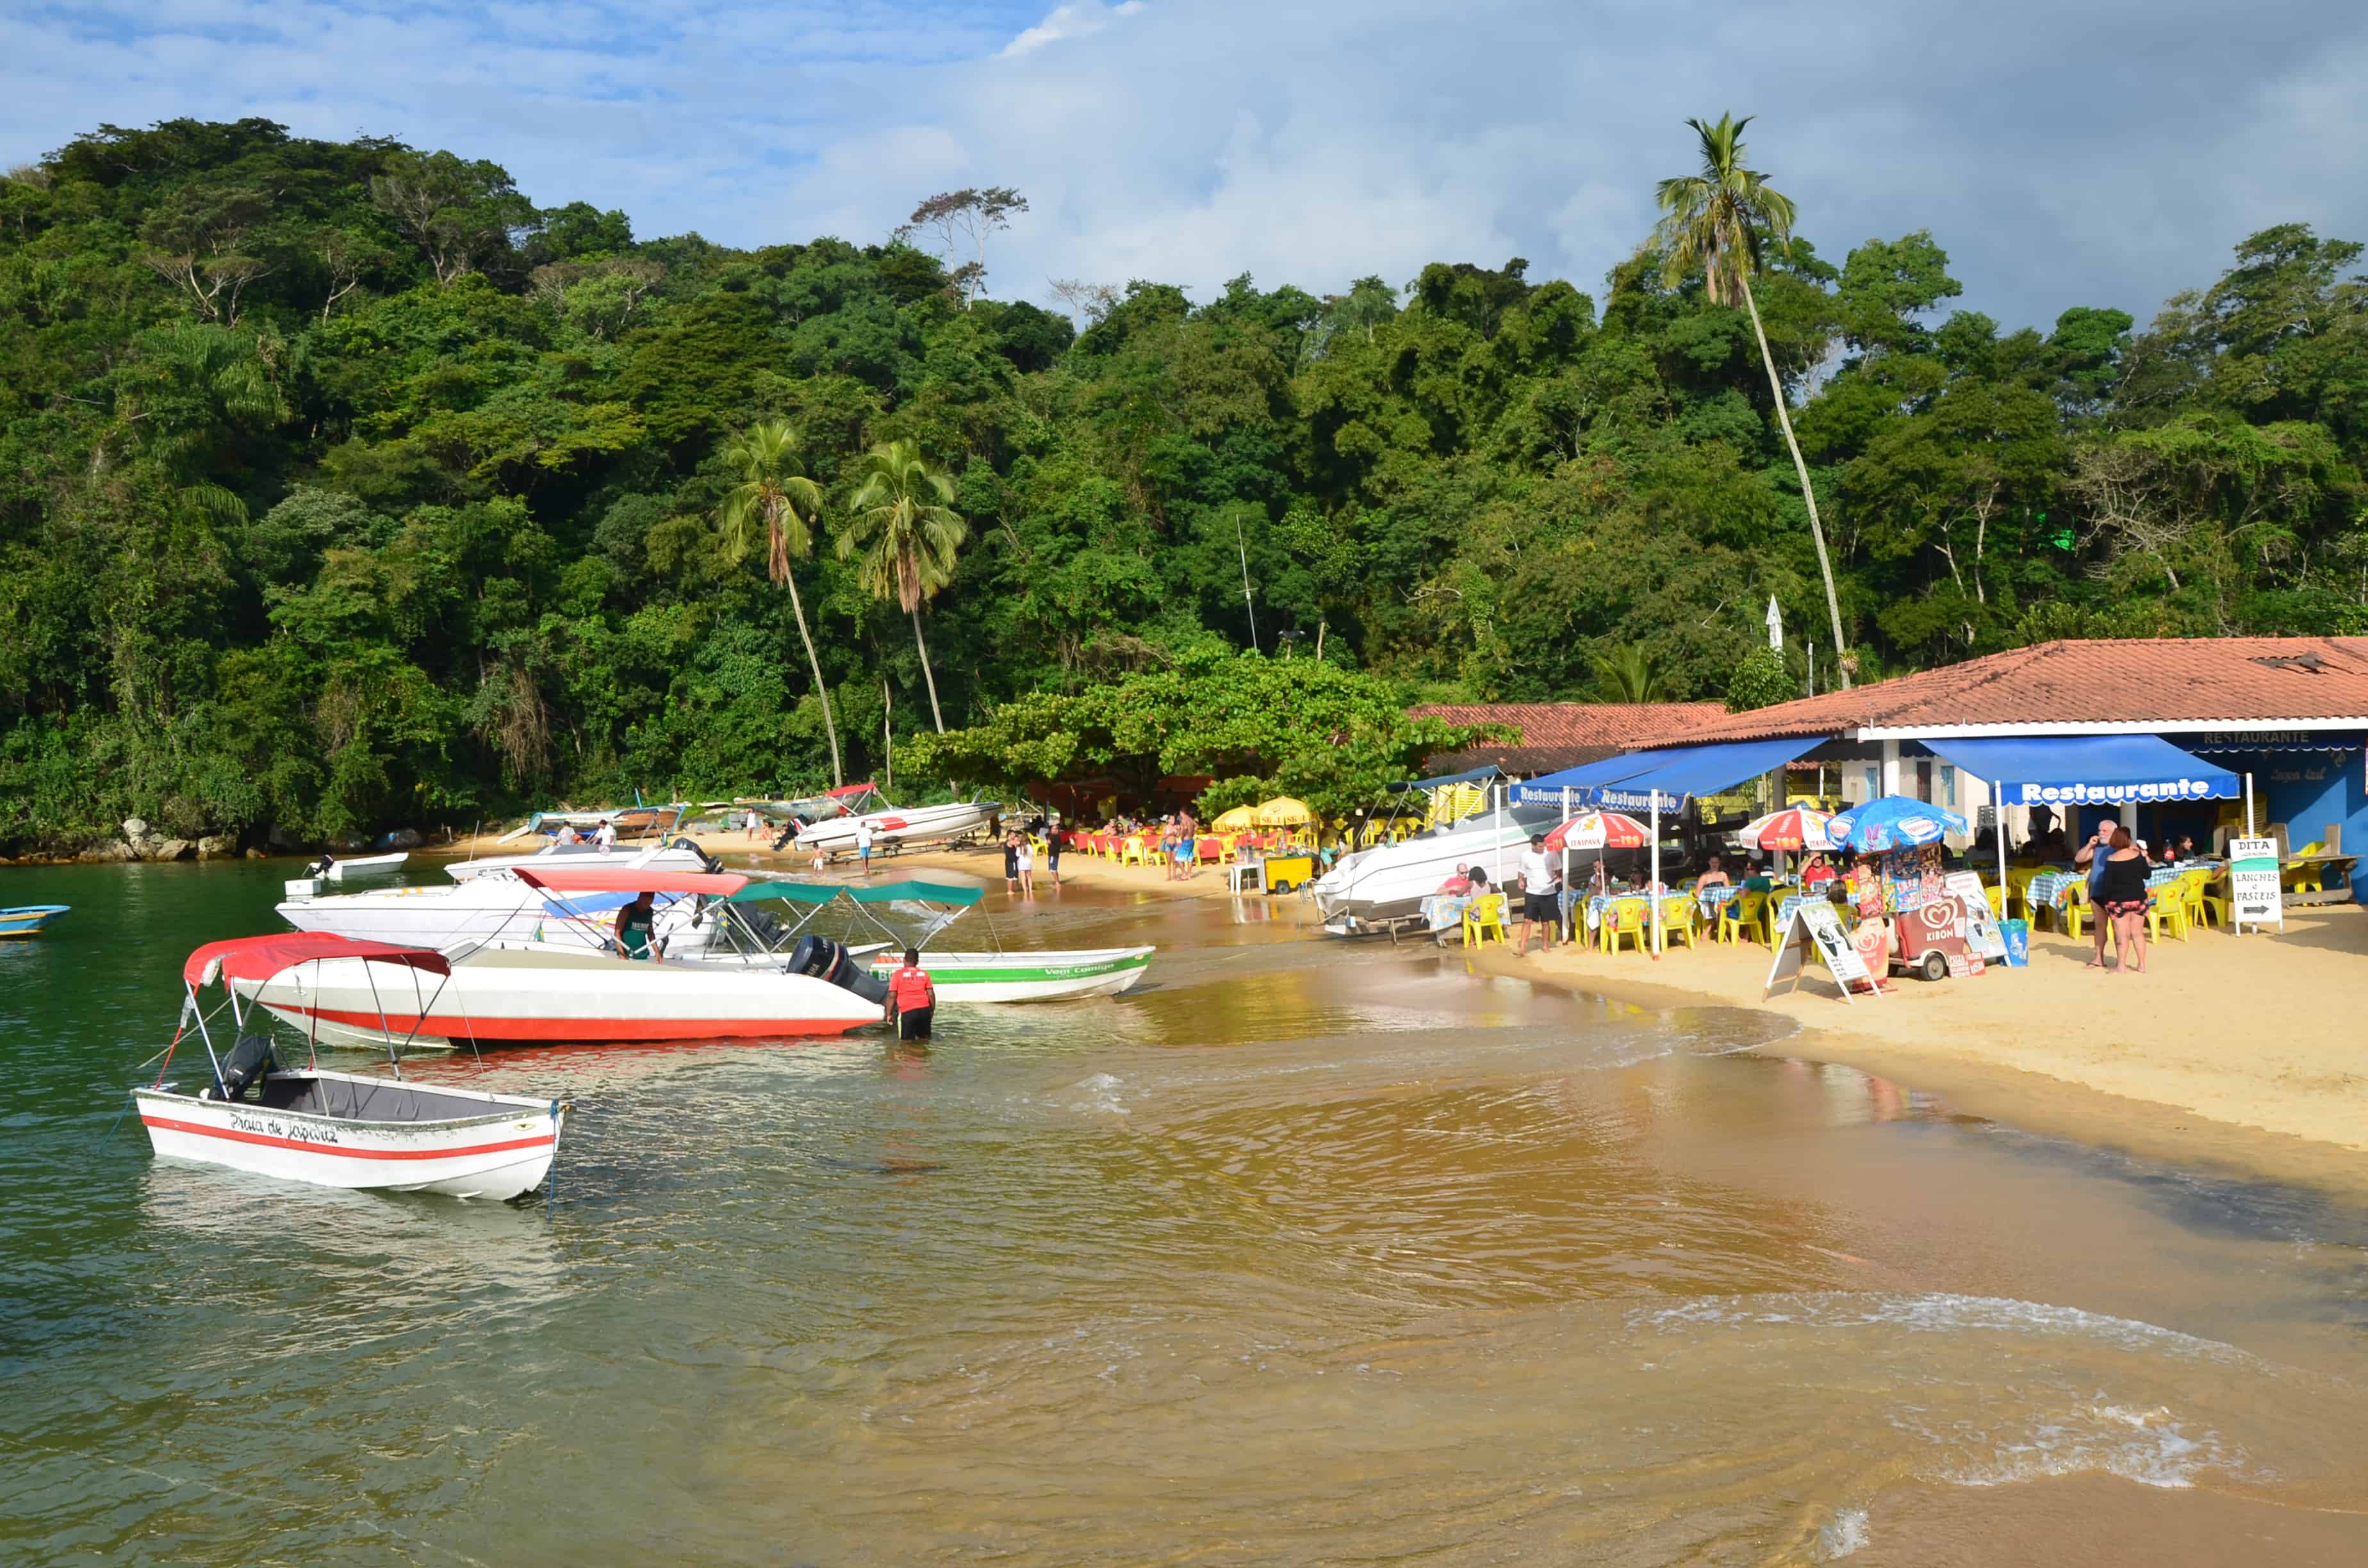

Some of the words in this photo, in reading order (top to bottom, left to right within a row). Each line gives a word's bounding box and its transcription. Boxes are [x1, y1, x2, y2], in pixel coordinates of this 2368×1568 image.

[2204, 731, 2309, 744] RESTAURANTE
[2021, 778, 2210, 801] Restaurante
[2239, 841, 2270, 850] DITA
[1927, 928, 1953, 942] KIBON
[230, 1113, 264, 1132] Praia
[268, 1120, 283, 1136] de
